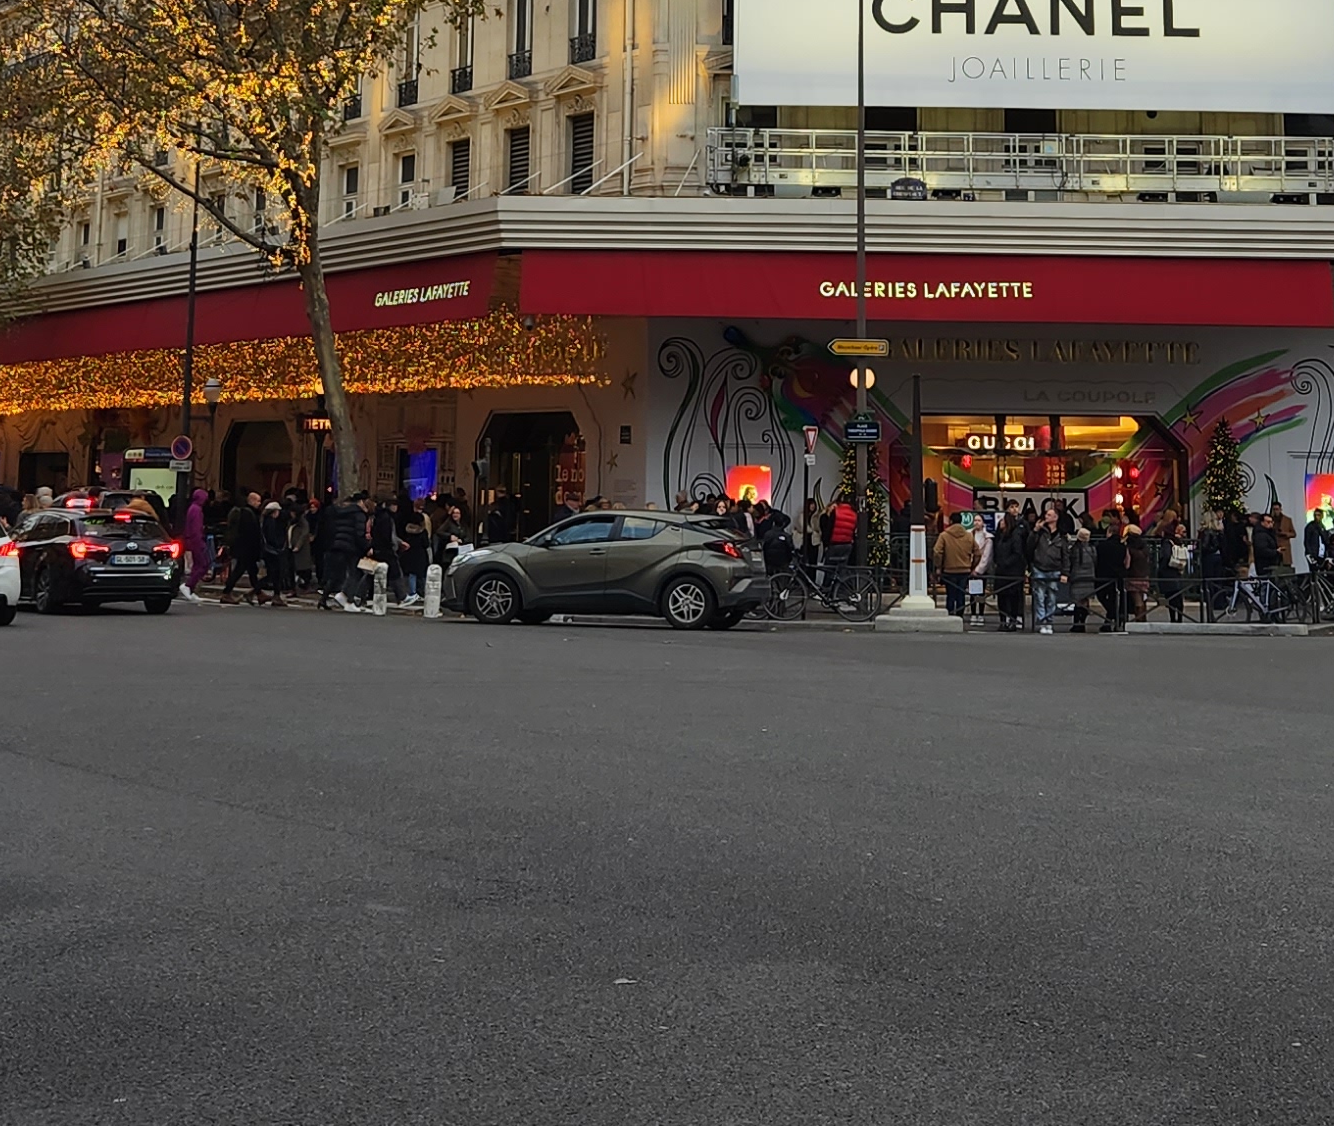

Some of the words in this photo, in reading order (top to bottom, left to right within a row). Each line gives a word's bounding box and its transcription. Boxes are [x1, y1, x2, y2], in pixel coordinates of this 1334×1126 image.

[947, 56, 1127, 84] JOAILLERIE
[374, 287, 419, 308] GALERIES
[419, 280, 471, 303] LAFAYETTE
[819, 281, 917, 298] GALERIES
[924, 282, 1034, 299] LAFAYETTE
[883, 339, 1022, 363] ALERIES
[1031, 340, 1201, 365] LAFAYETTE
[1023, 390, 1054, 403] LA
[1058, 390, 1157, 405] COUPOLE
[303, 418, 332, 430] METR
